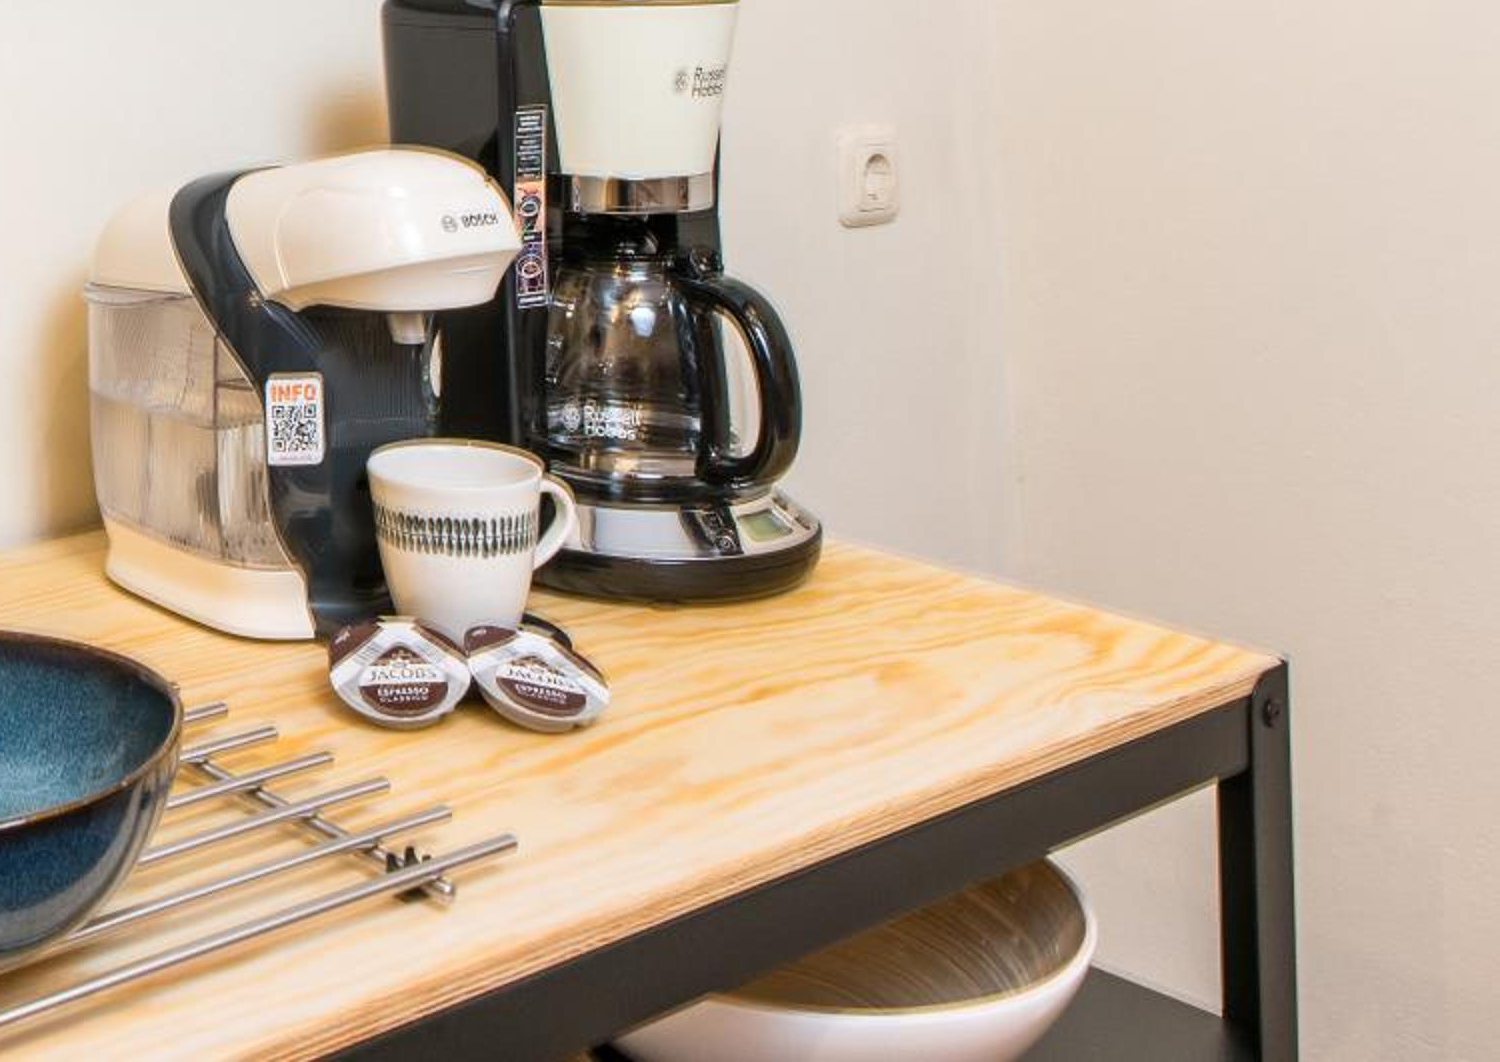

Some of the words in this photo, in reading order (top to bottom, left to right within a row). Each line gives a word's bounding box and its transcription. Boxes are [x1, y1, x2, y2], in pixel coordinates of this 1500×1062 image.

[461, 213, 499, 228] BOSCH
[270, 383, 318, 402] INFO
[583, 402, 643, 426] Russell
[370, 668, 438, 681] JACOBS
